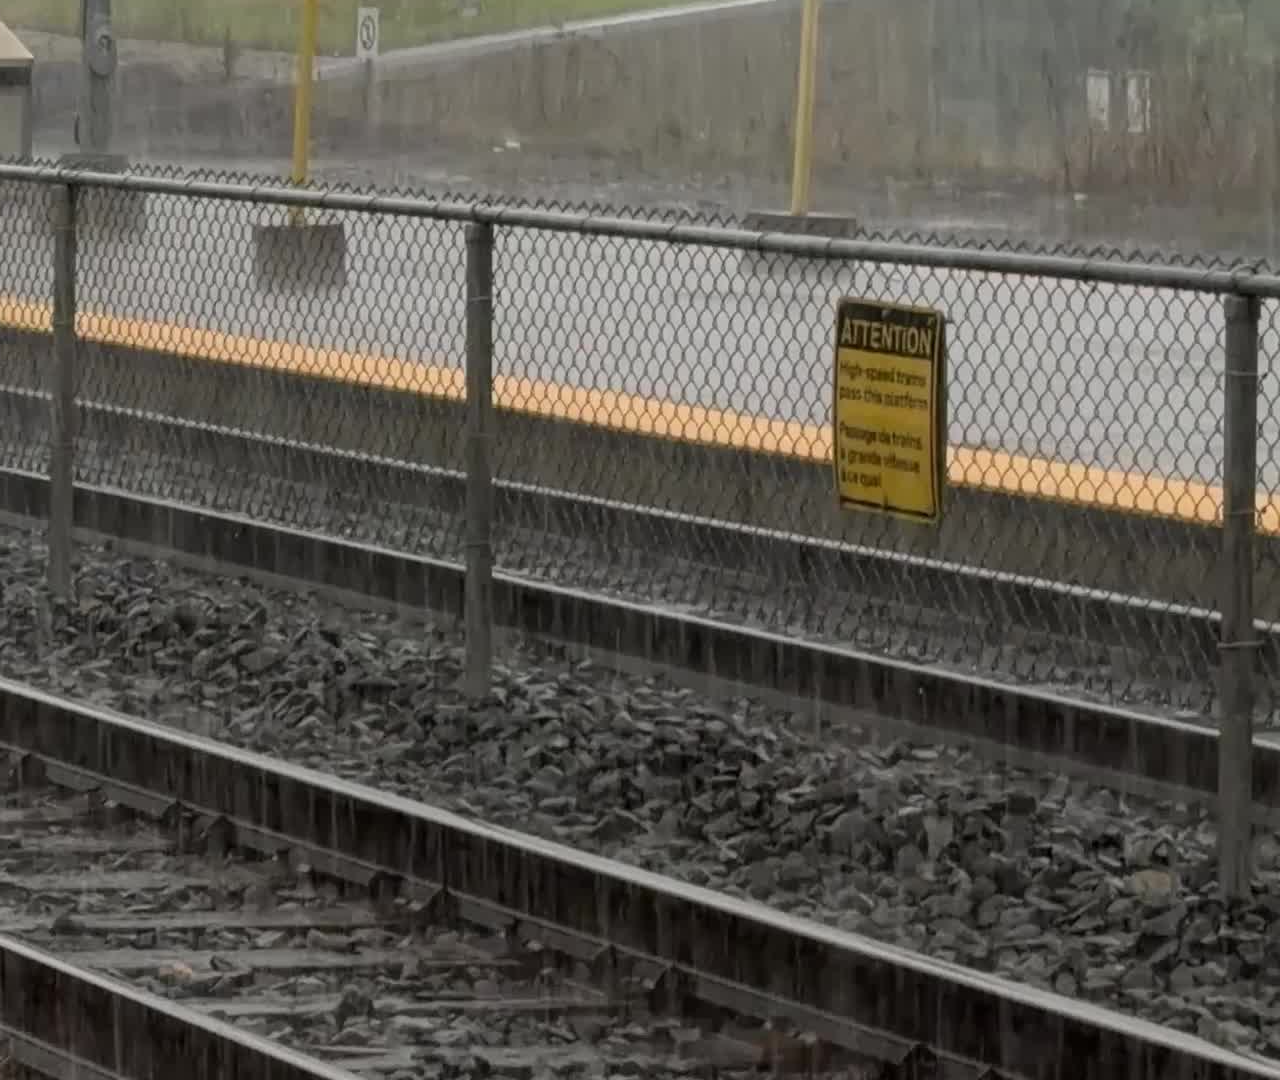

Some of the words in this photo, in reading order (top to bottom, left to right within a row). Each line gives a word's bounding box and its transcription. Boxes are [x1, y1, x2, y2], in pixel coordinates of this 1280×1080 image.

[840, 317, 932, 356] ATTENTION
[839, 386, 862, 401] pass
[863, 387, 882, 405] this
[884, 391, 928, 409] platform
[839, 420, 876, 445] Passage
[878, 429, 891, 445] de
[892, 431, 922, 450] trains
[859, 473, 882, 489] quai
